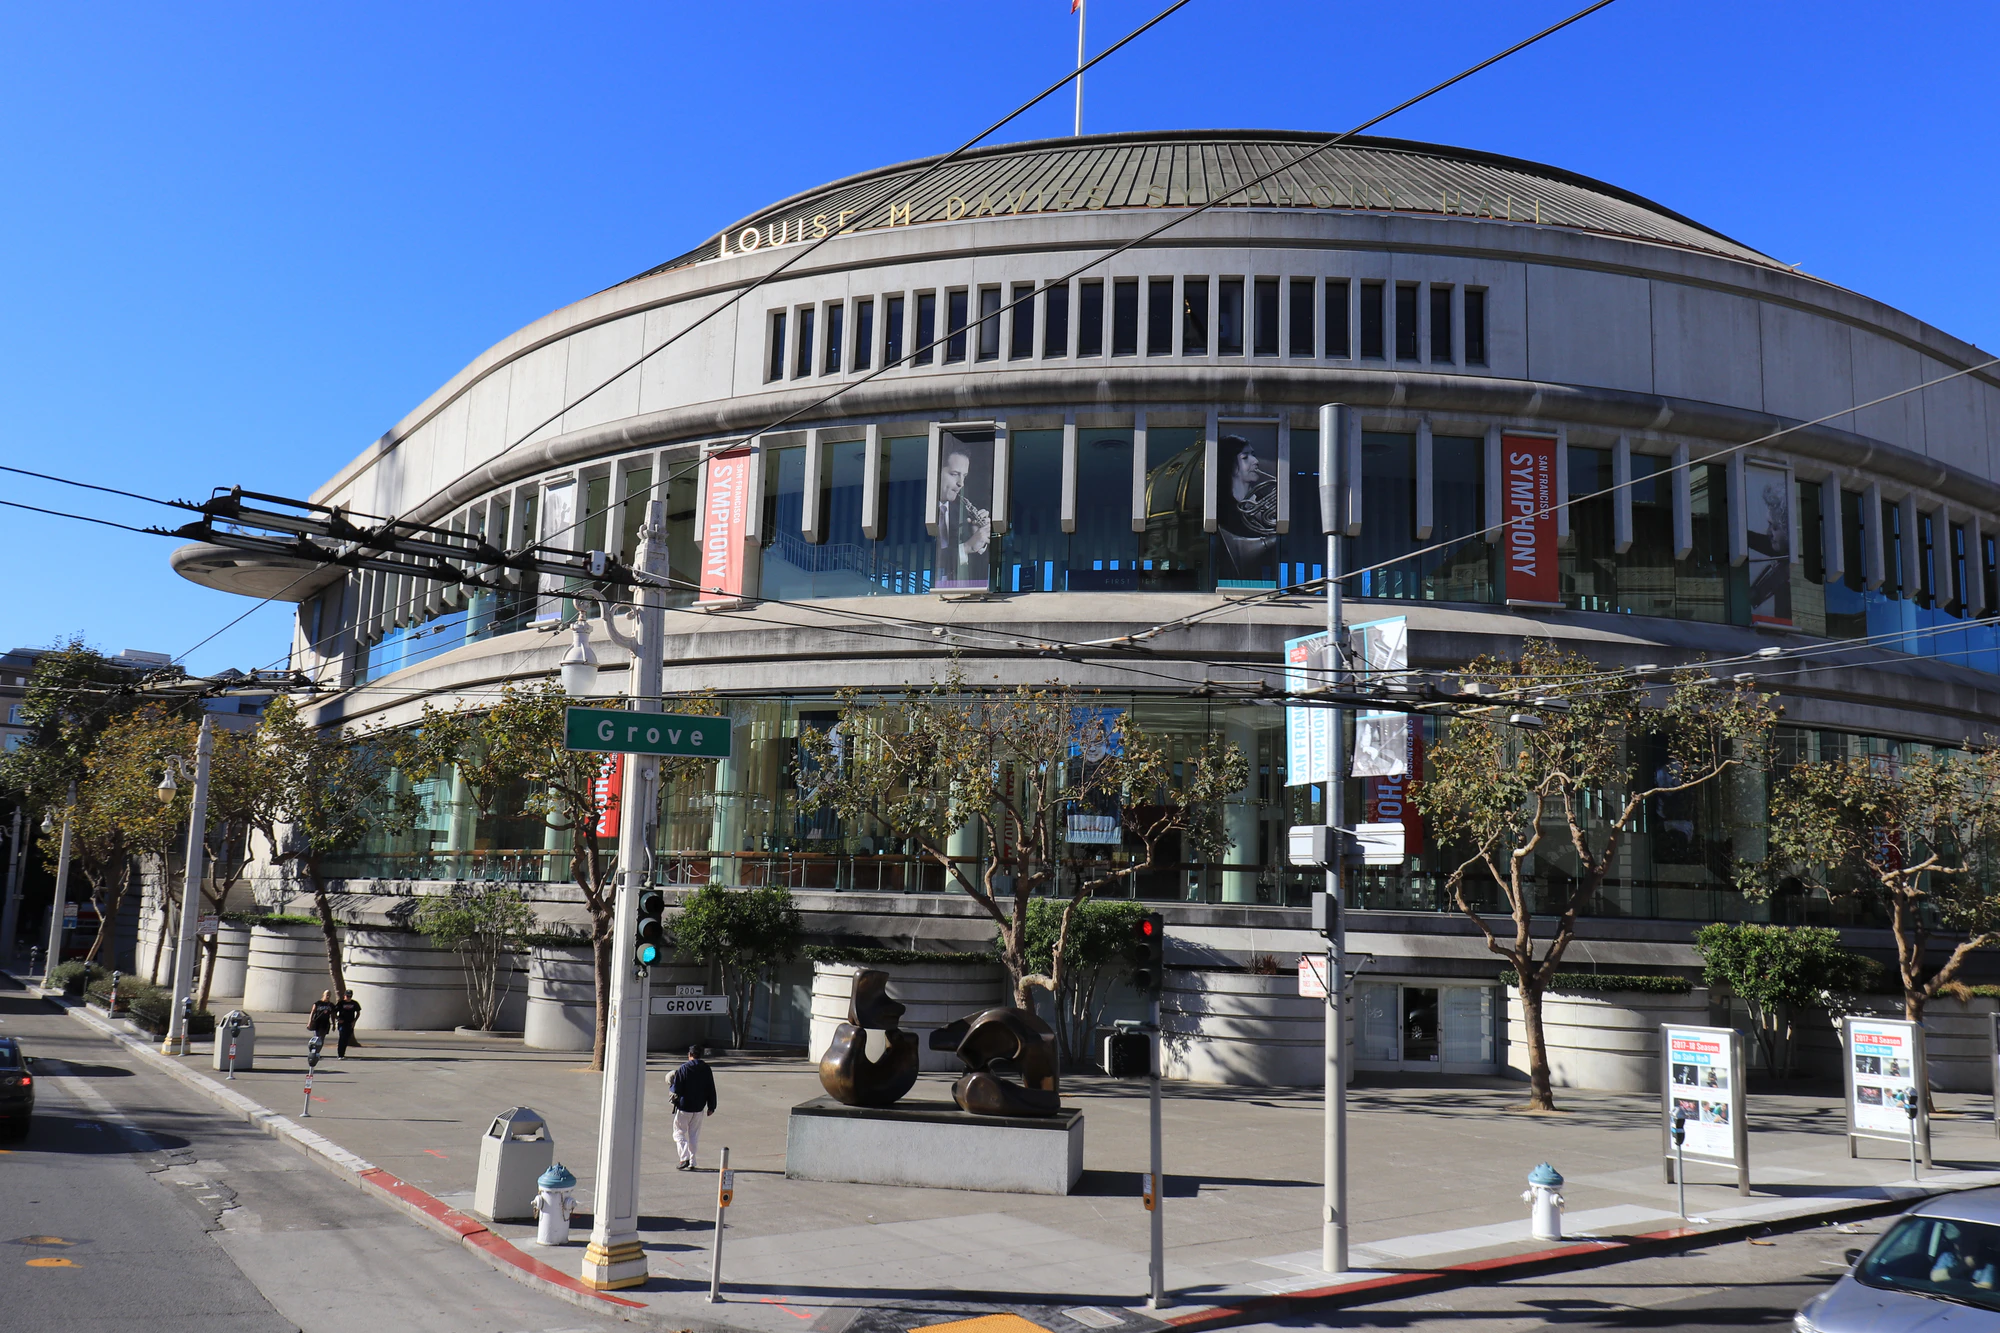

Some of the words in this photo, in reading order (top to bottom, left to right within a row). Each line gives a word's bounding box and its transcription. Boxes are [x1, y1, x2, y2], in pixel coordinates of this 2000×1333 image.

[719, 210, 855, 258] LOUISE
[889, 200, 911, 228] M
[946, 187, 1105, 222] DAVIES
[1146, 182, 1401, 212] SYMPHONY
[1442, 189, 1552, 225] HALL
[735, 463, 744, 479] SAN
[1538, 455, 1548, 472] SAN
[732, 481, 743, 524] FRANCISCO
[1509, 452, 1537, 577] SYMPHONY
[706, 465, 733, 578] SYMPHONY
[597, 719, 704, 746] Grove
[1313, 708, 1325, 779] SYMPHON
[1295, 754, 1307, 781] SAN
[679, 987, 695, 995] 200
[666, 1000, 713, 1012] GROVE
[1696, 1042, 1719, 1052] Season
[1878, 1036, 1901, 1045] Season
